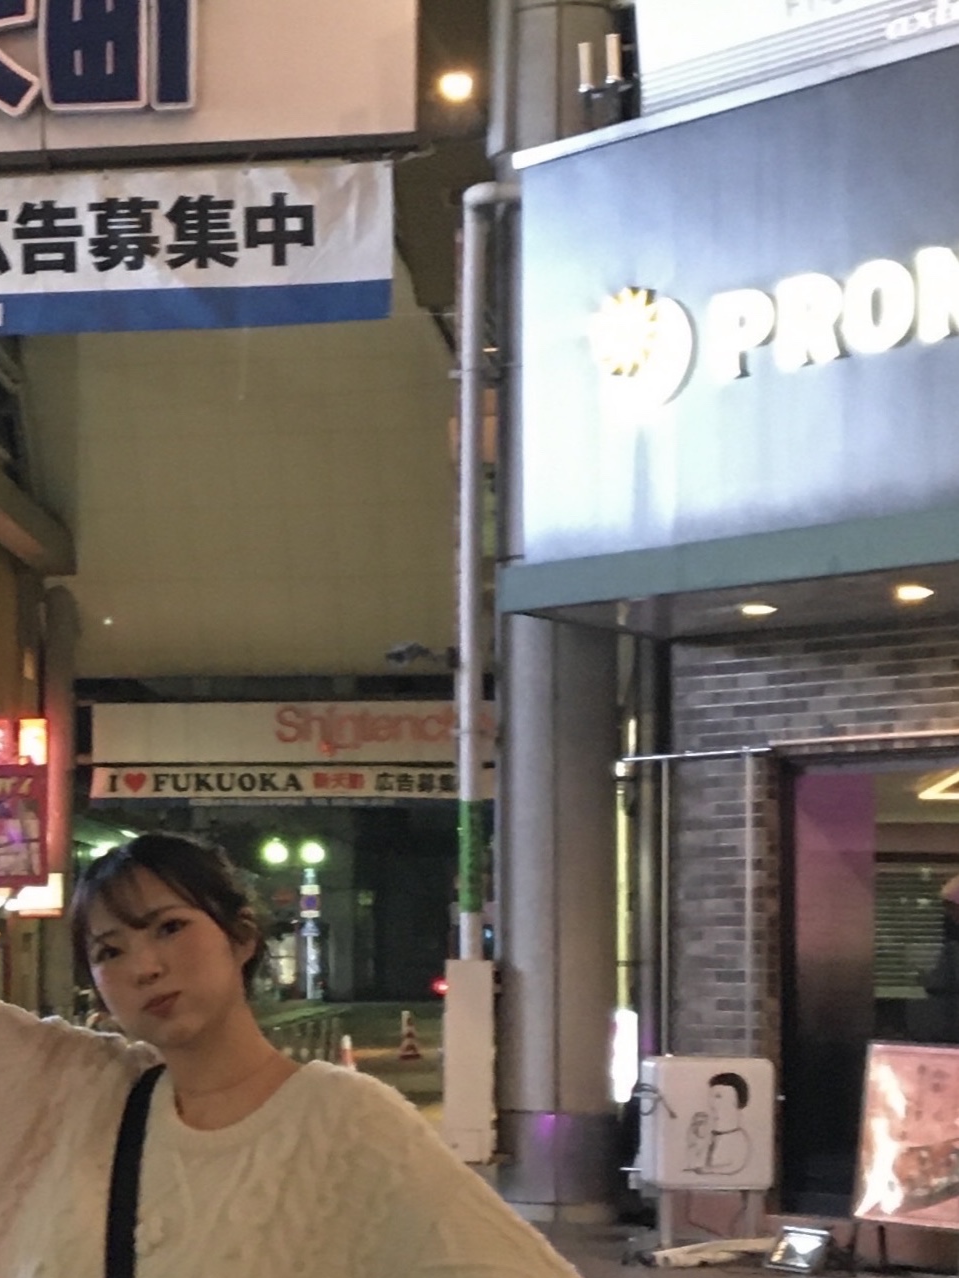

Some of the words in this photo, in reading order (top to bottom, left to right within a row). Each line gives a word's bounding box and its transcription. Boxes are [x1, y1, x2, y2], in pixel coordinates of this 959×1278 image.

[107, 774, 118, 792] I
[152, 773, 303, 792] FUKUOKA
[375, 773, 460, 793] 広告募集
